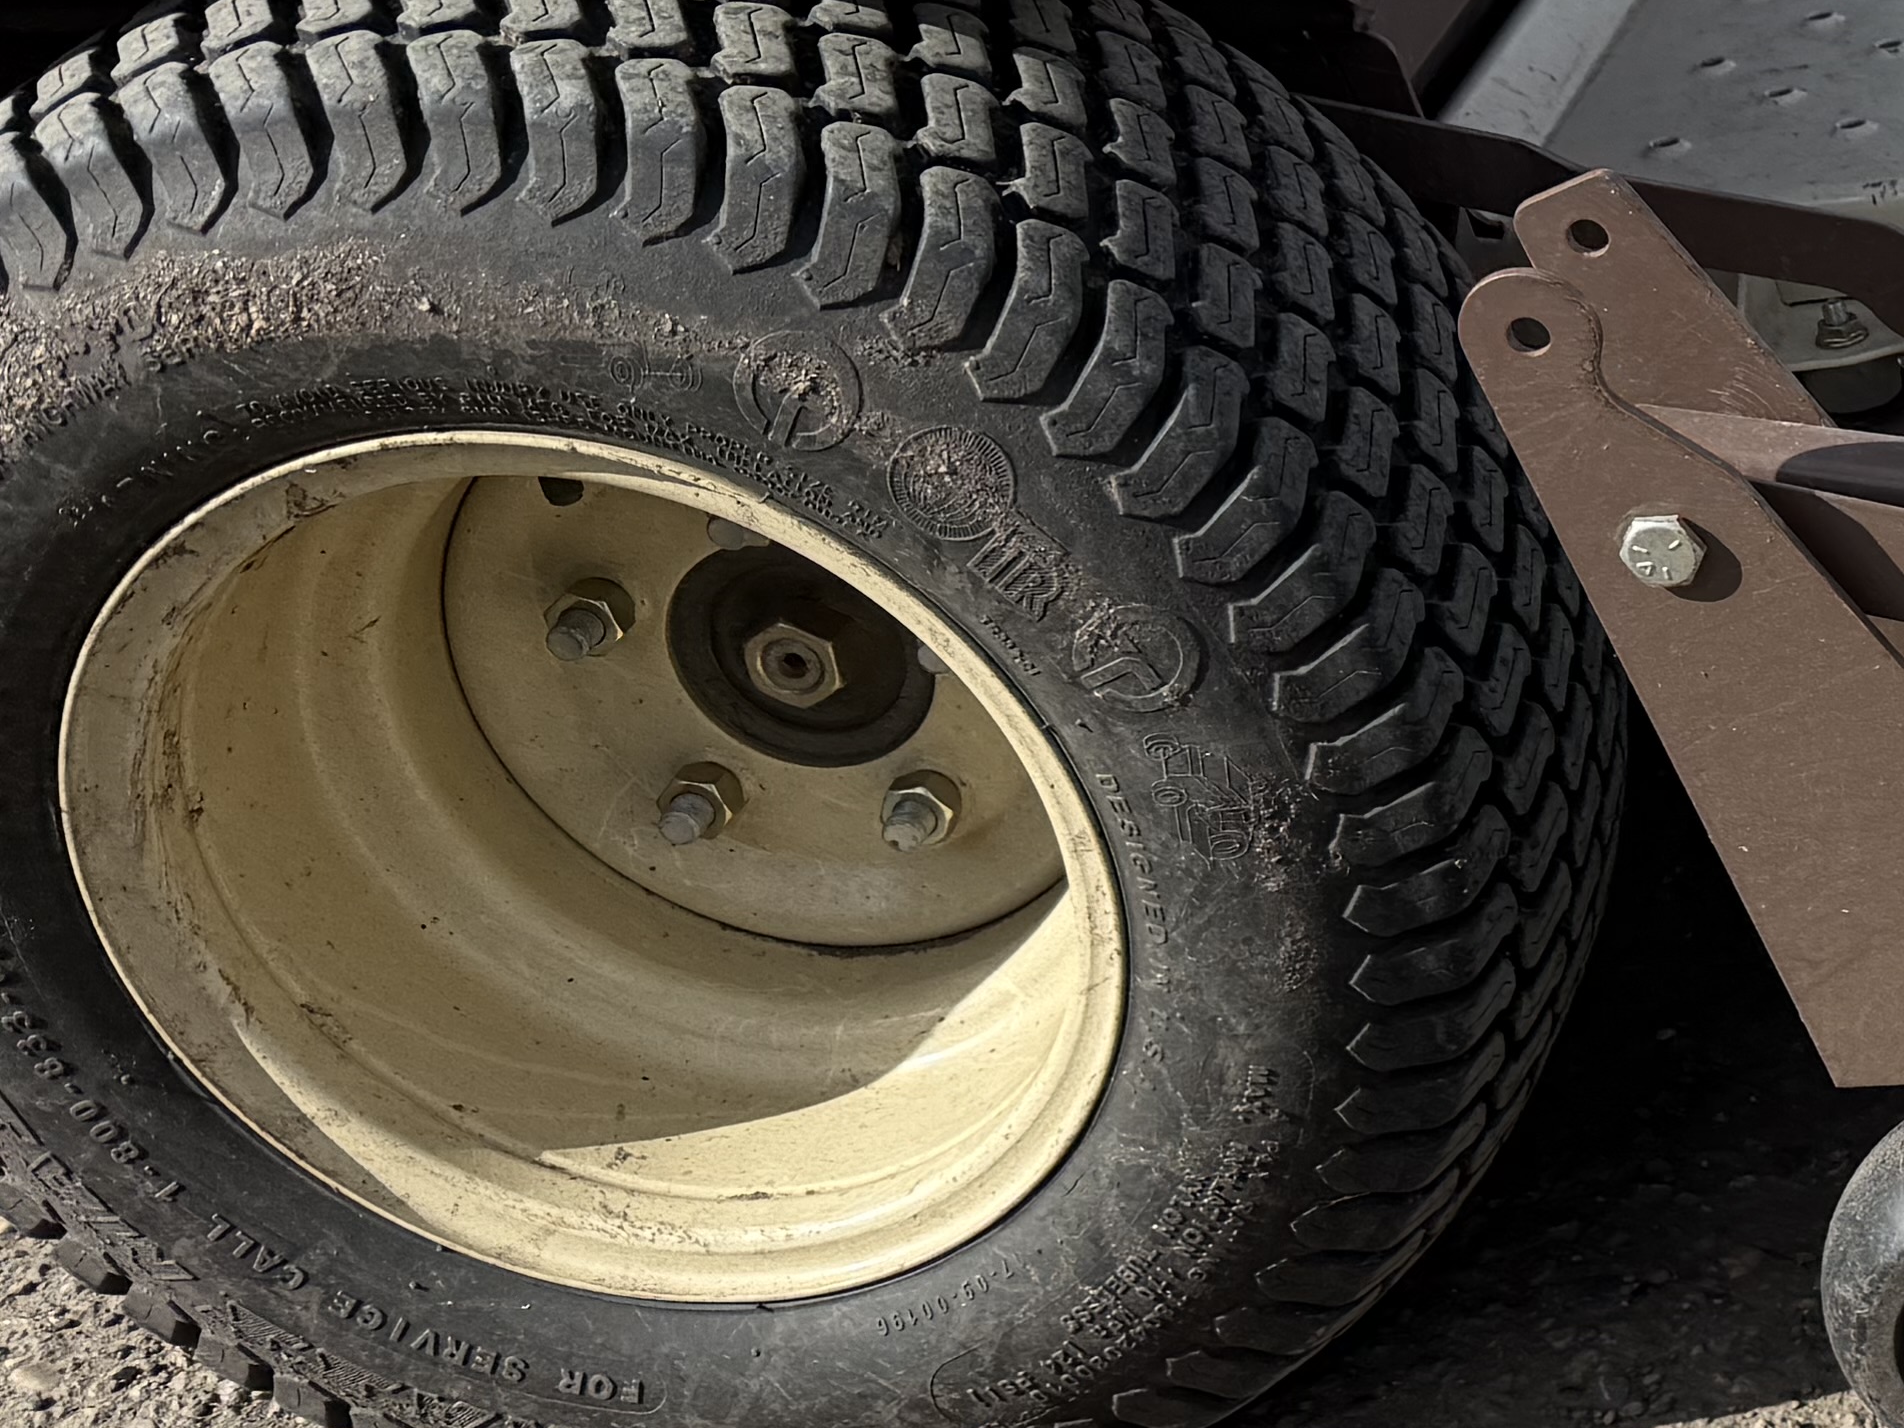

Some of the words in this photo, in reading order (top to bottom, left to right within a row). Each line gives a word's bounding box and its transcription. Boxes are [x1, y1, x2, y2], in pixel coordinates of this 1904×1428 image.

[1095, 772, 1171, 946] DESIGNED
[203, 1212, 308, 1291] CALL
[327, 1288, 529, 1384] SERVICE
[557, 1367, 644, 1406] FOR
